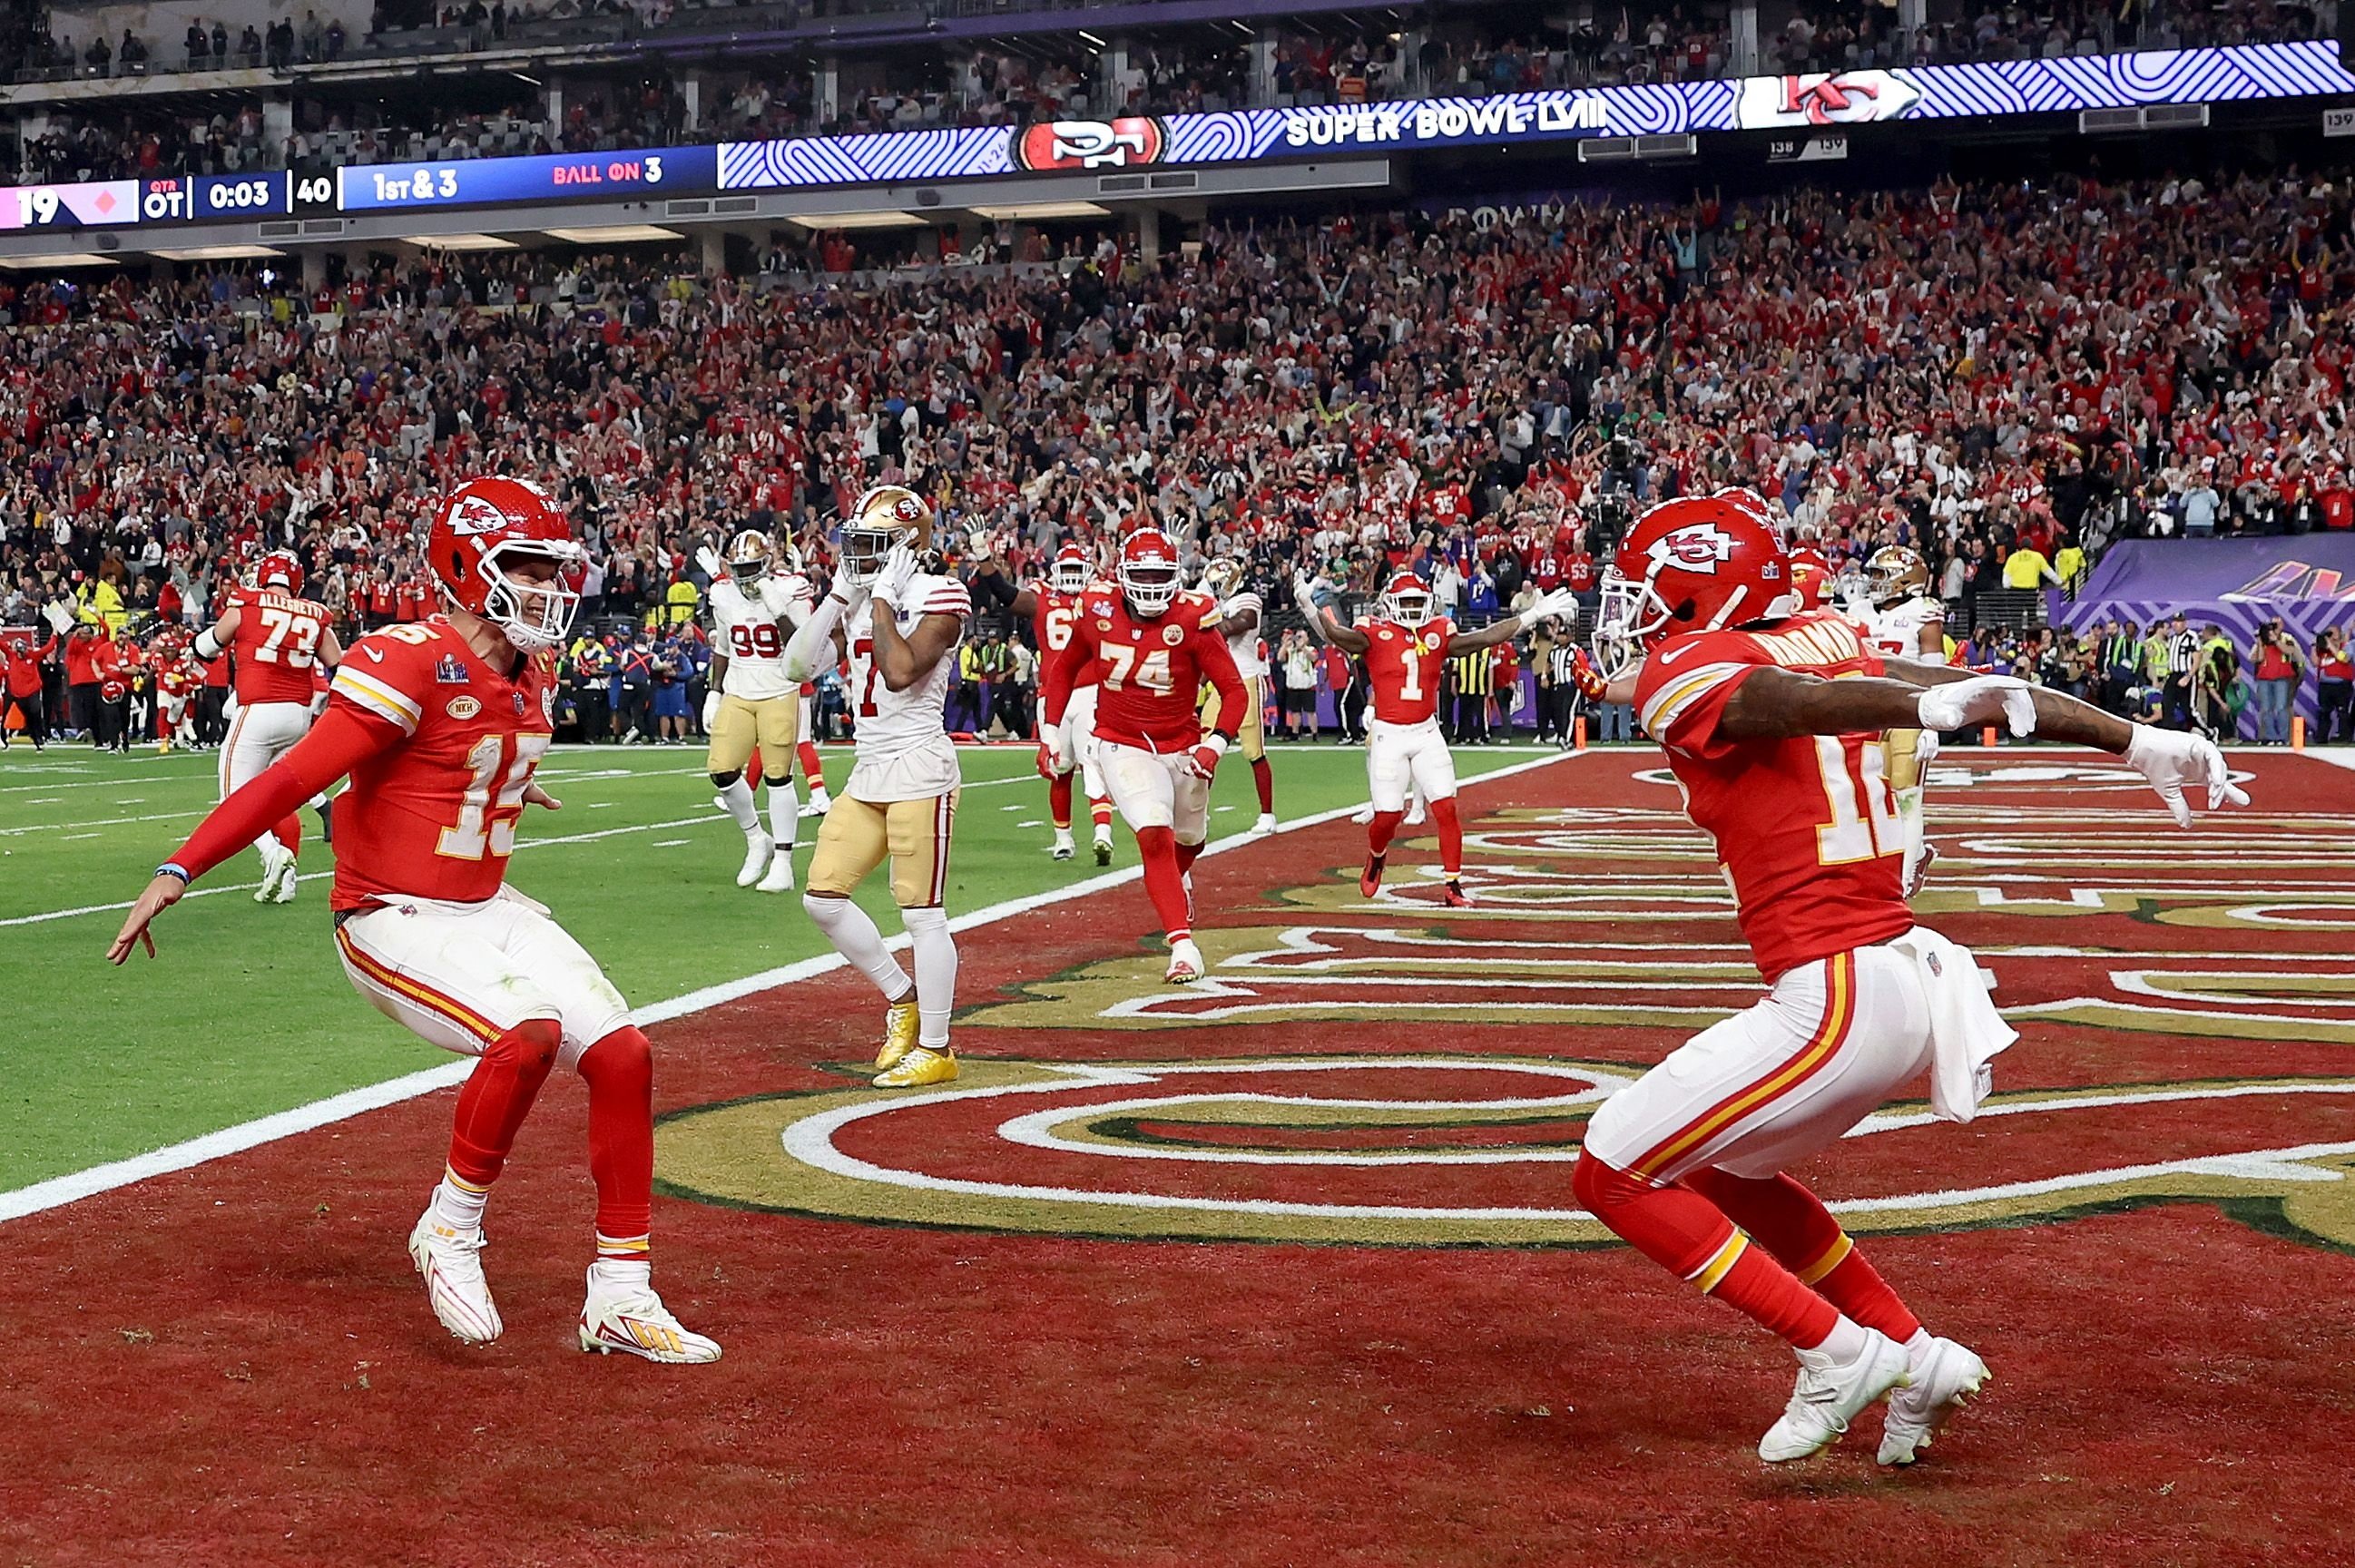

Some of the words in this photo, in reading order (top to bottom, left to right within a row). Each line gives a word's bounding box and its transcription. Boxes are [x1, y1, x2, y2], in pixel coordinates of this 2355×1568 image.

[1286, 111, 1399, 146] SUPER
[1417, 103, 1526, 139] BOWL
[1538, 97, 1607, 131] LVIII
[412, 169, 435, 200] &
[438, 169, 458, 198] 3
[553, 165, 602, 185] BALL
[608, 162, 640, 182] ON
[643, 156, 662, 183] 3
[150, 180, 178, 192] QTR
[209, 181, 270, 210] 0:03
[296, 177, 332, 203] 40
[15, 187, 59, 225] 19
[143, 191, 184, 219] OT
[1434, 495, 1454, 515] 35
[1665, 534, 1719, 564] KC
[1571, 563, 1588, 581] 53
[254, 607, 320, 669] 73
[731, 623, 782, 659] 99
[1099, 640, 1176, 698] 74
[1399, 648, 1423, 701] 1
[434, 731, 554, 861] 15
